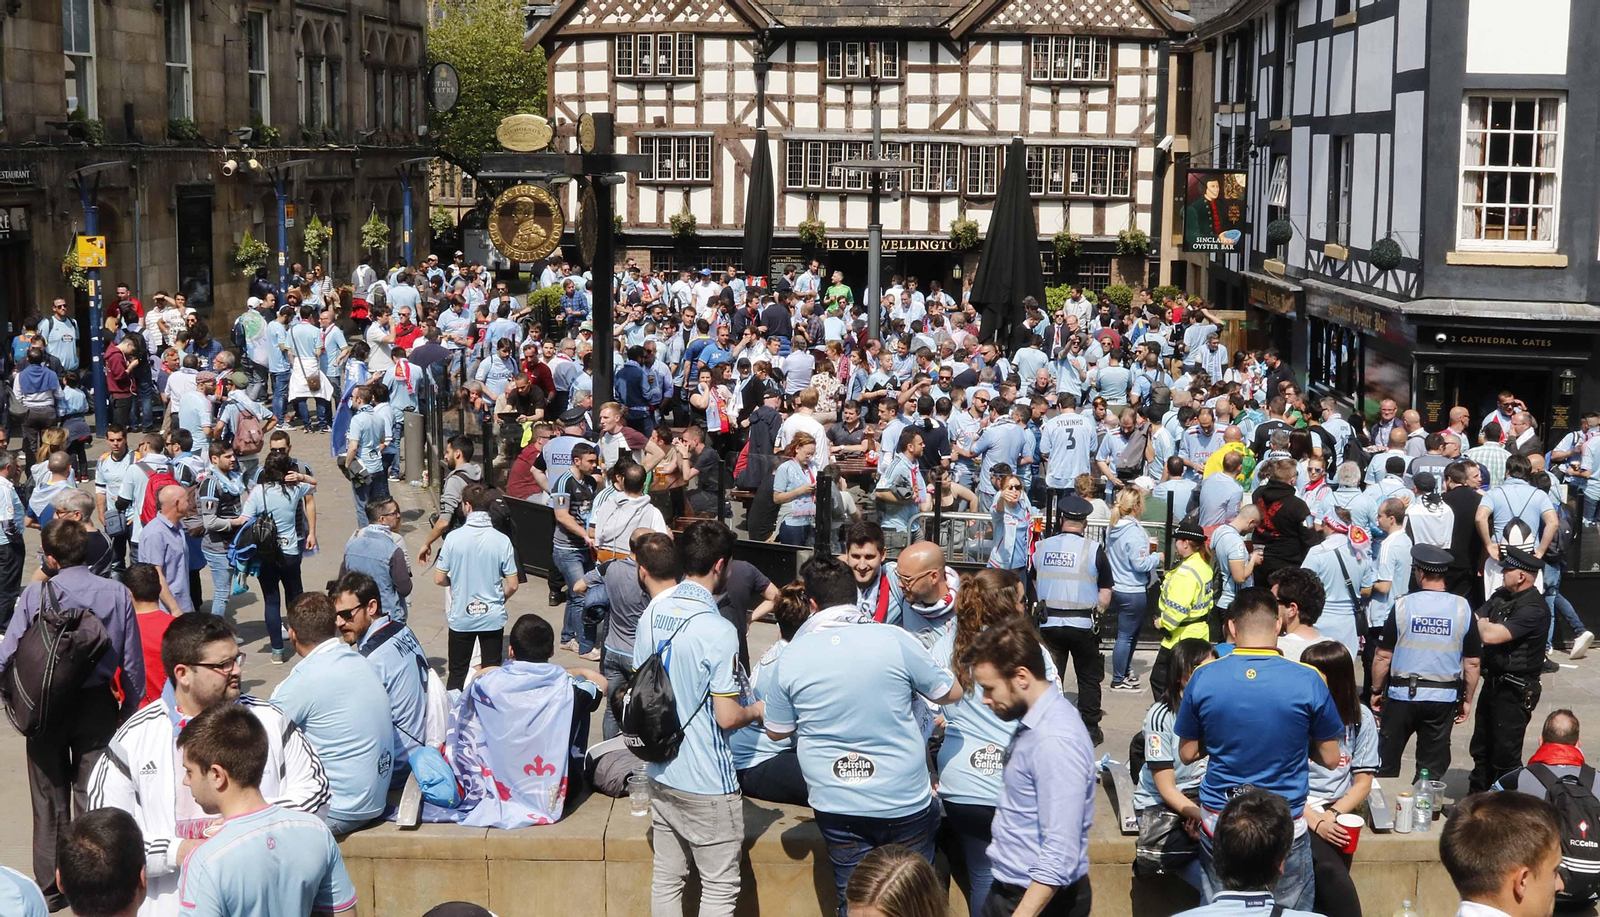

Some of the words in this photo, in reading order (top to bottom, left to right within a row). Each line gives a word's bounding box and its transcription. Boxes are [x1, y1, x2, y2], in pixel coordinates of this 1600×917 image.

[515, 186, 537, 196] THE
[489, 222, 502, 246] OLD
[502, 223, 562, 262] WELLINGTON
[845, 239, 869, 250] OLD
[881, 240, 962, 250] WELLINGTO
[1374, 311, 1387, 334] Bar
[1461, 336, 1518, 345] CATHEDRAL
[1522, 338, 1552, 347] GATES
[1056, 419, 1083, 427] SYLVINHO
[1065, 428, 1076, 450] 3
[553, 453, 572, 461] POLICE
[1046, 552, 1073, 561] POLICE
[1044, 559, 1073, 567] LIAISON
[1415, 617, 1449, 627] POLICE
[1413, 625, 1450, 635] LIAISON
[974, 750, 1002, 761] Estrell
[837, 760, 871, 769] Estrella
[974, 759, 1004, 770] Galicia
[839, 768, 870, 777] Galicia
[1569, 839, 1599, 848] RCCelta
